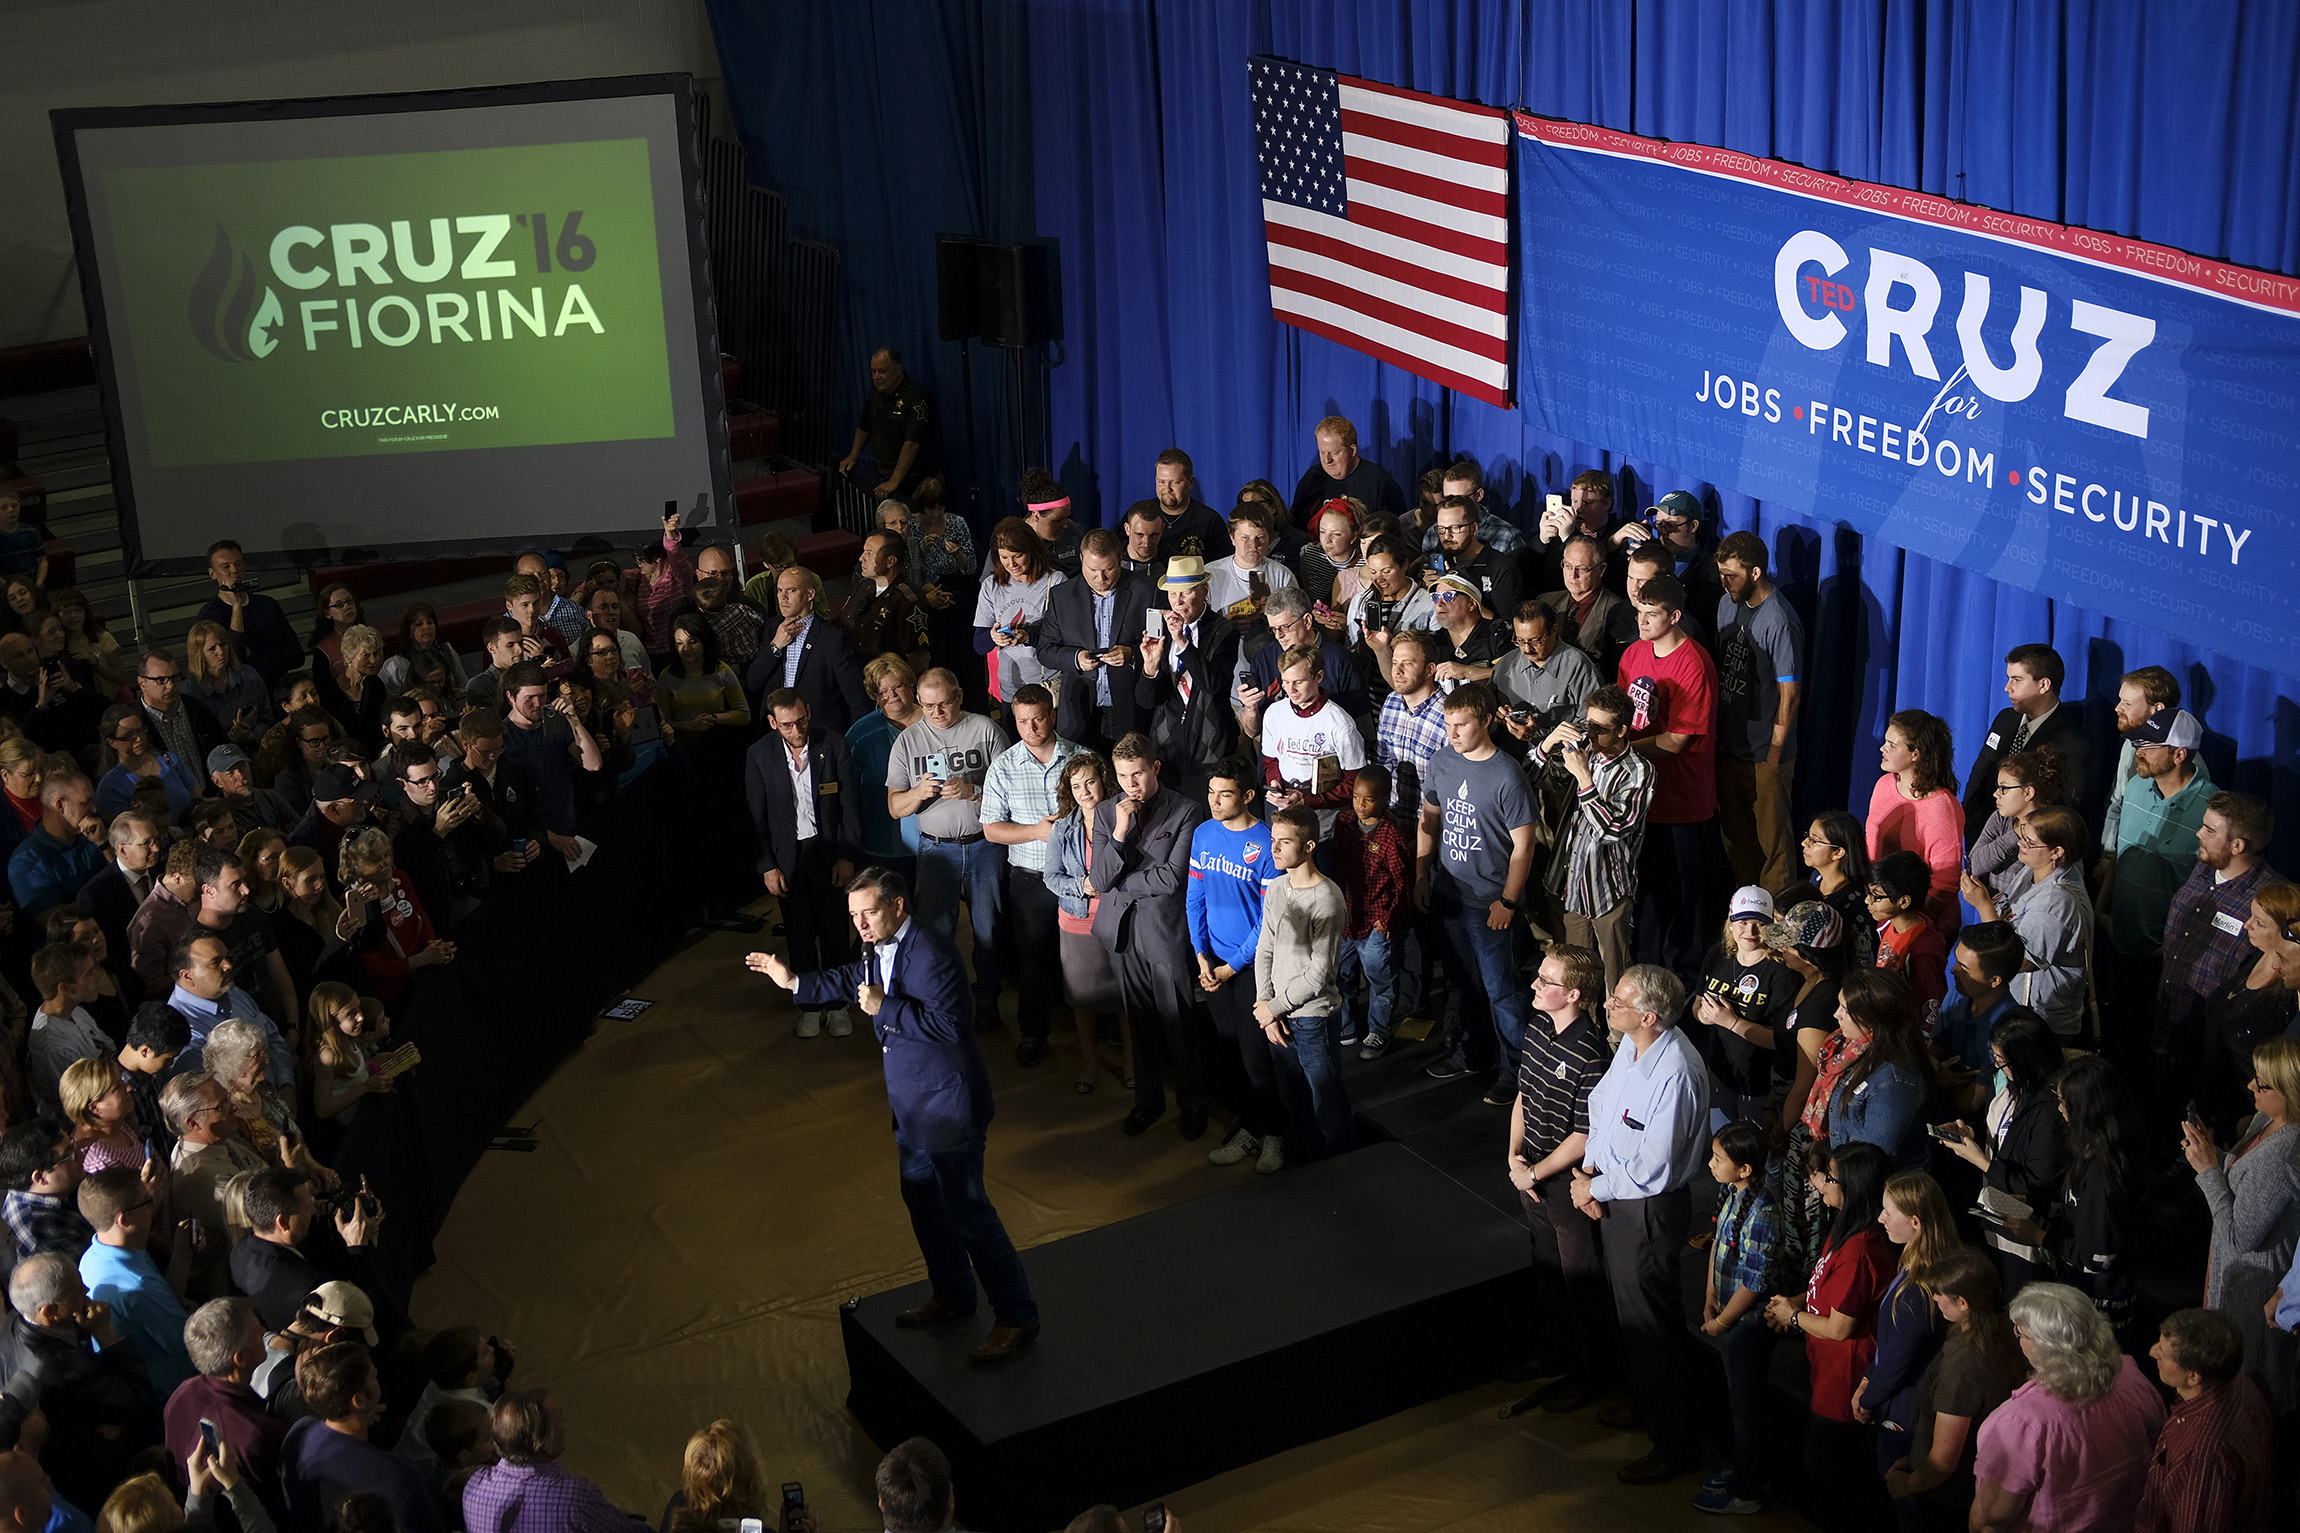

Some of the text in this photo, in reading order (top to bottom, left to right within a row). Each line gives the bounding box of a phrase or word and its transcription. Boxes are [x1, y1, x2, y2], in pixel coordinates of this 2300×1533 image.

[1546, 125, 1599, 142] FREEDOM
[1670, 147, 1702, 163] JOBS
[1712, 153, 1771, 177] FREEDOM
[1780, 169, 1844, 194] SECURITY
[1854, 188, 1890, 206] JOBS
[1902, 196, 1970, 224] FREEDOM
[1982, 215, 2054, 241] SECURITY
[2072, 233, 2111, 254] JOBS
[2126, 245, 2201, 277] FREEDOM
[2215, 268, 2299, 301] SECURITY
[269, 210, 597, 290] CRUZ '16
[1805, 276, 1855, 311] TED
[299, 284, 605, 351] FIORINA
[1775, 230, 2156, 438] CRUZ
[321, 402, 500, 429] CRUZCARLY.COM
[1912, 363, 1982, 446] for
[1695, 370, 2252, 566] JOBS FREEDOM SECURITY
[1727, 640, 1749, 659] KEEP
[1445, 811, 1477, 830] CALM
[1447, 797, 1475, 816] KEEP
[1442, 829, 1482, 851] CRUZ
[1453, 826, 1465, 834] AND
[1200, 850, 1253, 881] Taiwan
[1449, 848, 1467, 862] ON
